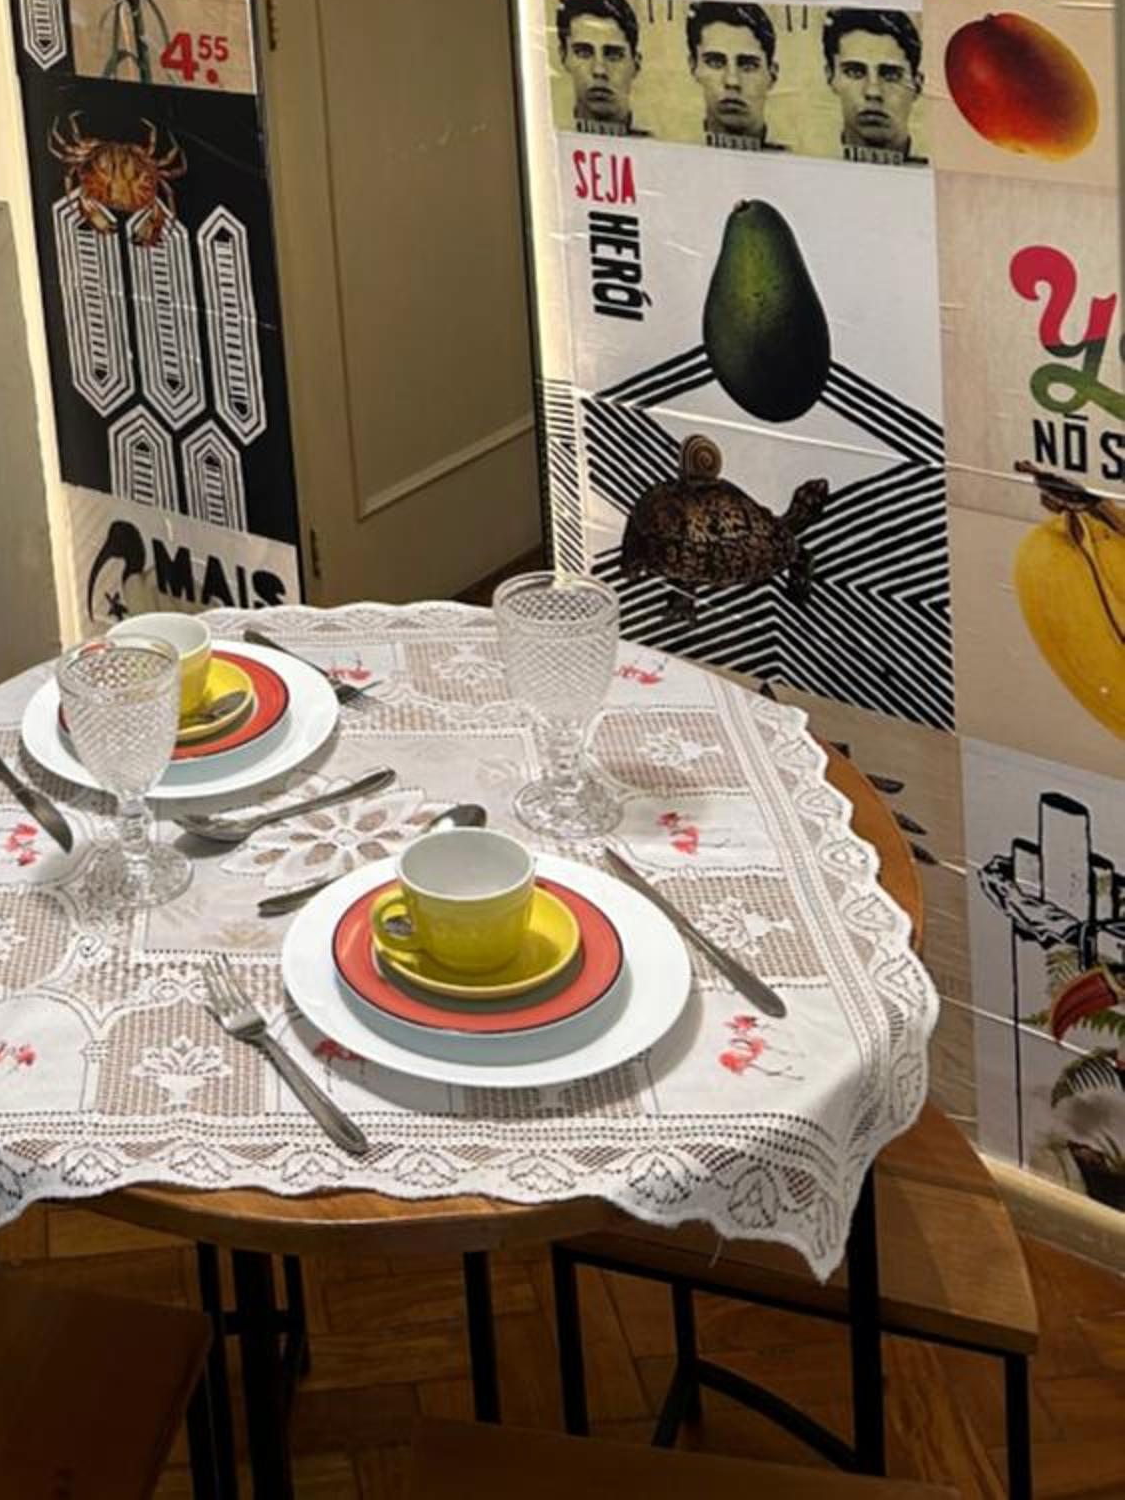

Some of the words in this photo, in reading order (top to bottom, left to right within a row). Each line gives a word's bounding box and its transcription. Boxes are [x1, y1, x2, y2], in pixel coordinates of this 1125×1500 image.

[572, 150, 636, 204] SEJA
[588, 210, 653, 322] HERÓI
[151, 537, 287, 610] MAIS
